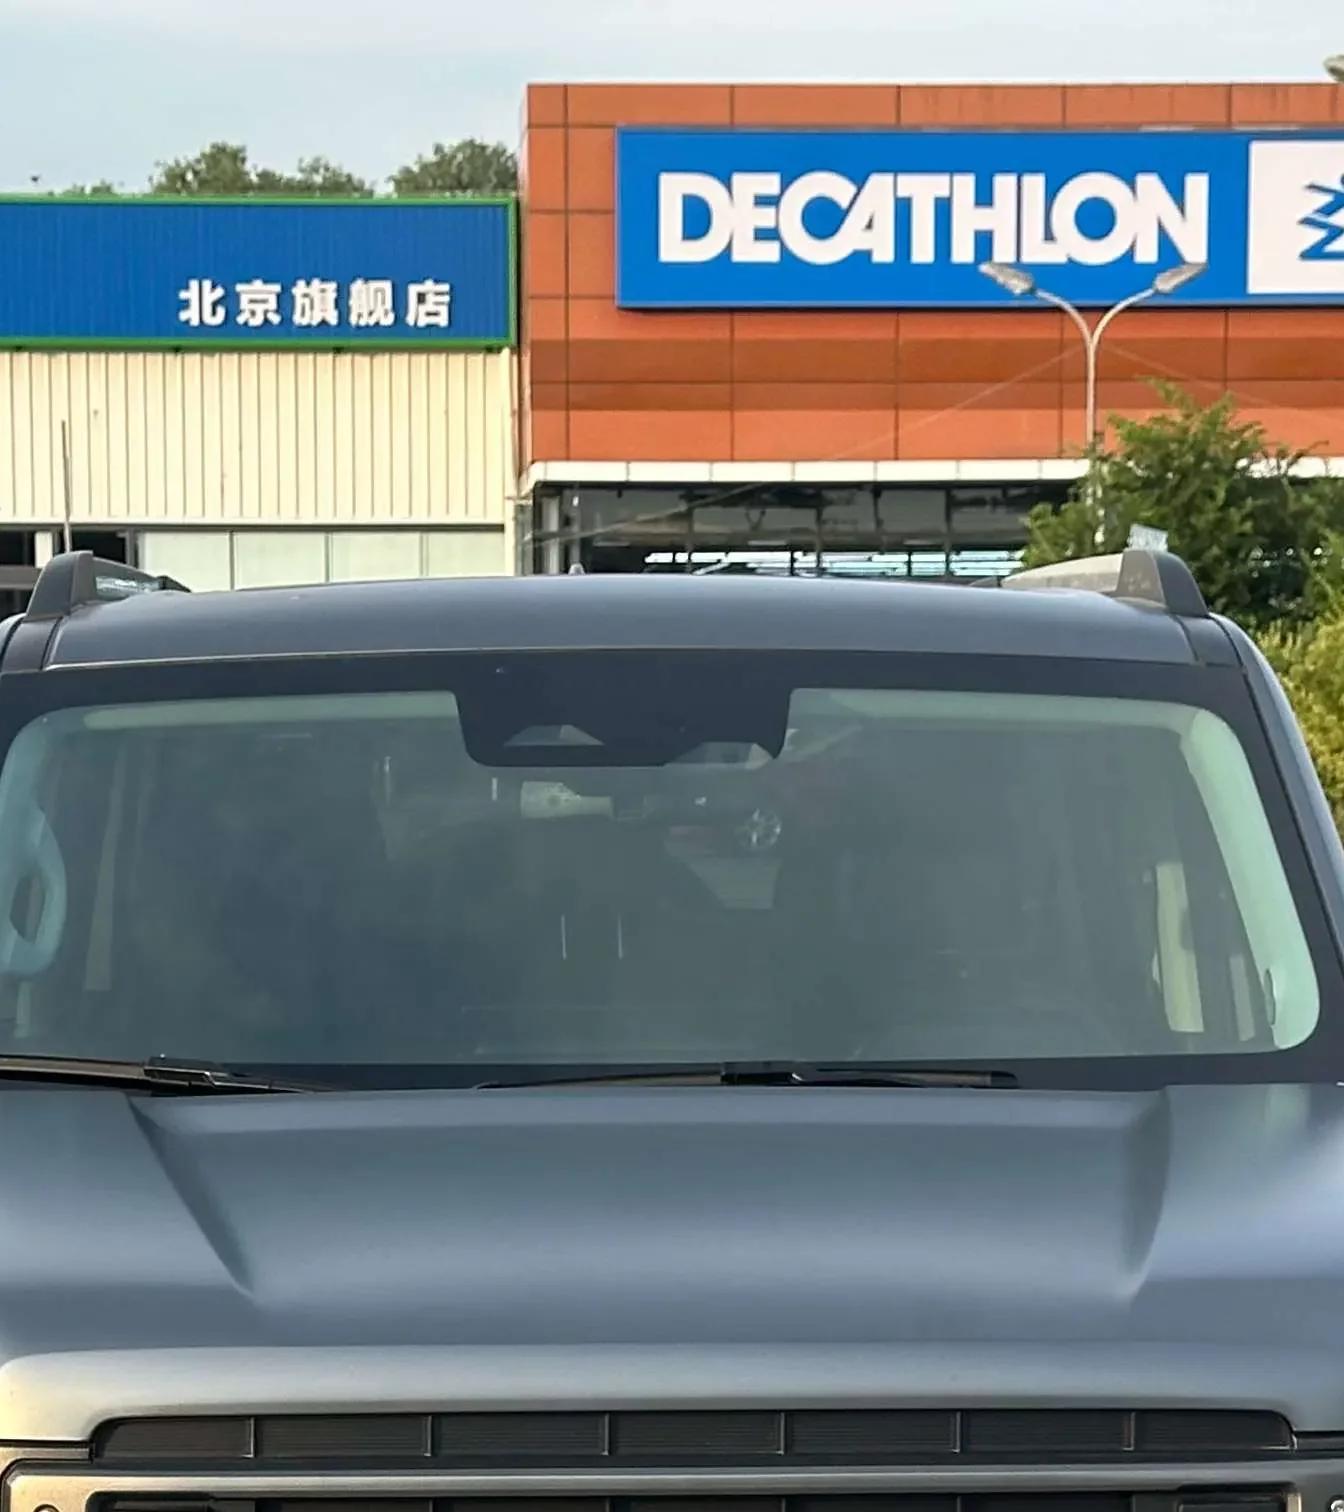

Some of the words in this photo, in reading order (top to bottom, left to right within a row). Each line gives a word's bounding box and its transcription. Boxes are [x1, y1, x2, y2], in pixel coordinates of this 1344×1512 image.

[658, 171, 1209, 264] DECATHLON
[178, 279, 452, 328] 北京旗舰店
